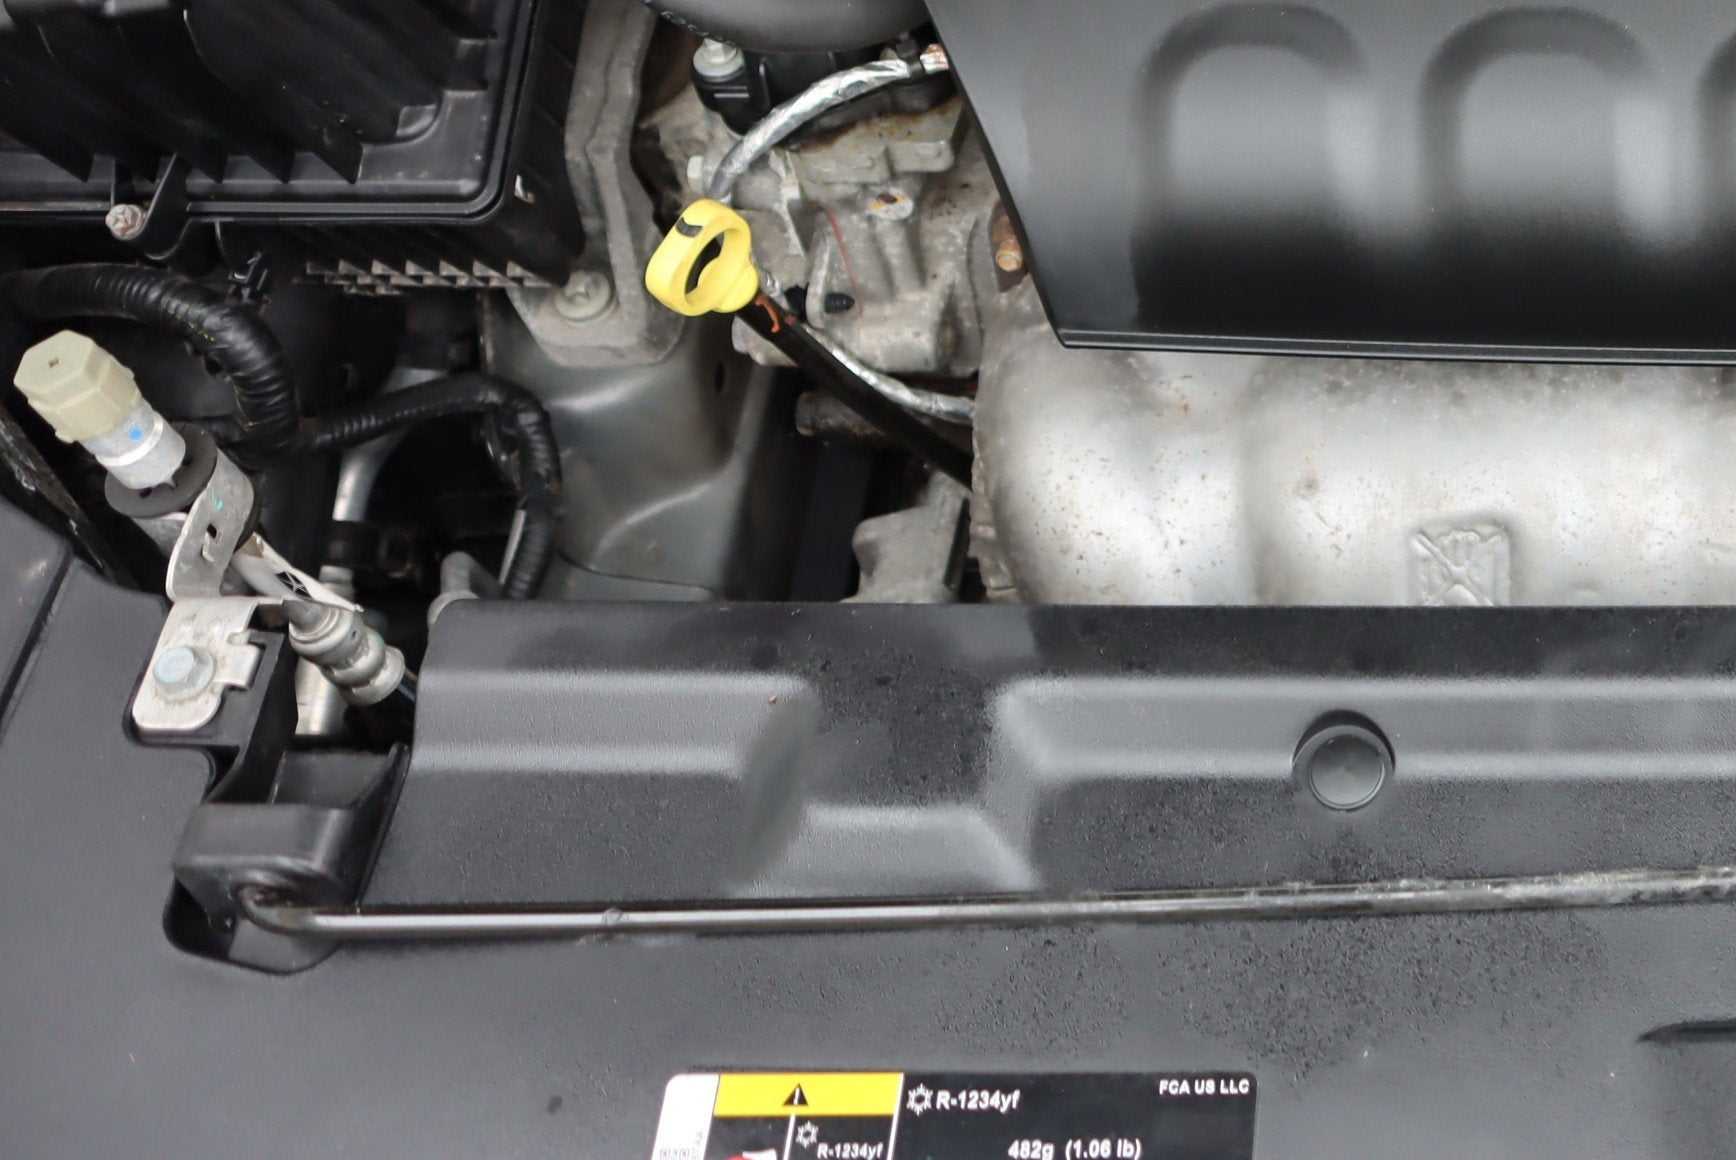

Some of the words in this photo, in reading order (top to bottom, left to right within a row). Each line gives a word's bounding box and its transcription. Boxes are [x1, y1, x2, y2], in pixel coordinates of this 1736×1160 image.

[1158, 1078, 1190, 1095] FCA
[1194, 1079, 1216, 1095] US
[1219, 1078, 1250, 1095] LLC
[936, 1089, 1020, 1113] R-1234yf
[817, 1141, 884, 1160] R-1234yf
[1008, 1138, 1054, 1160] 482g
[1065, 1138, 1112, 1160] (1.06
[1117, 1138, 1142, 1160] lb)
